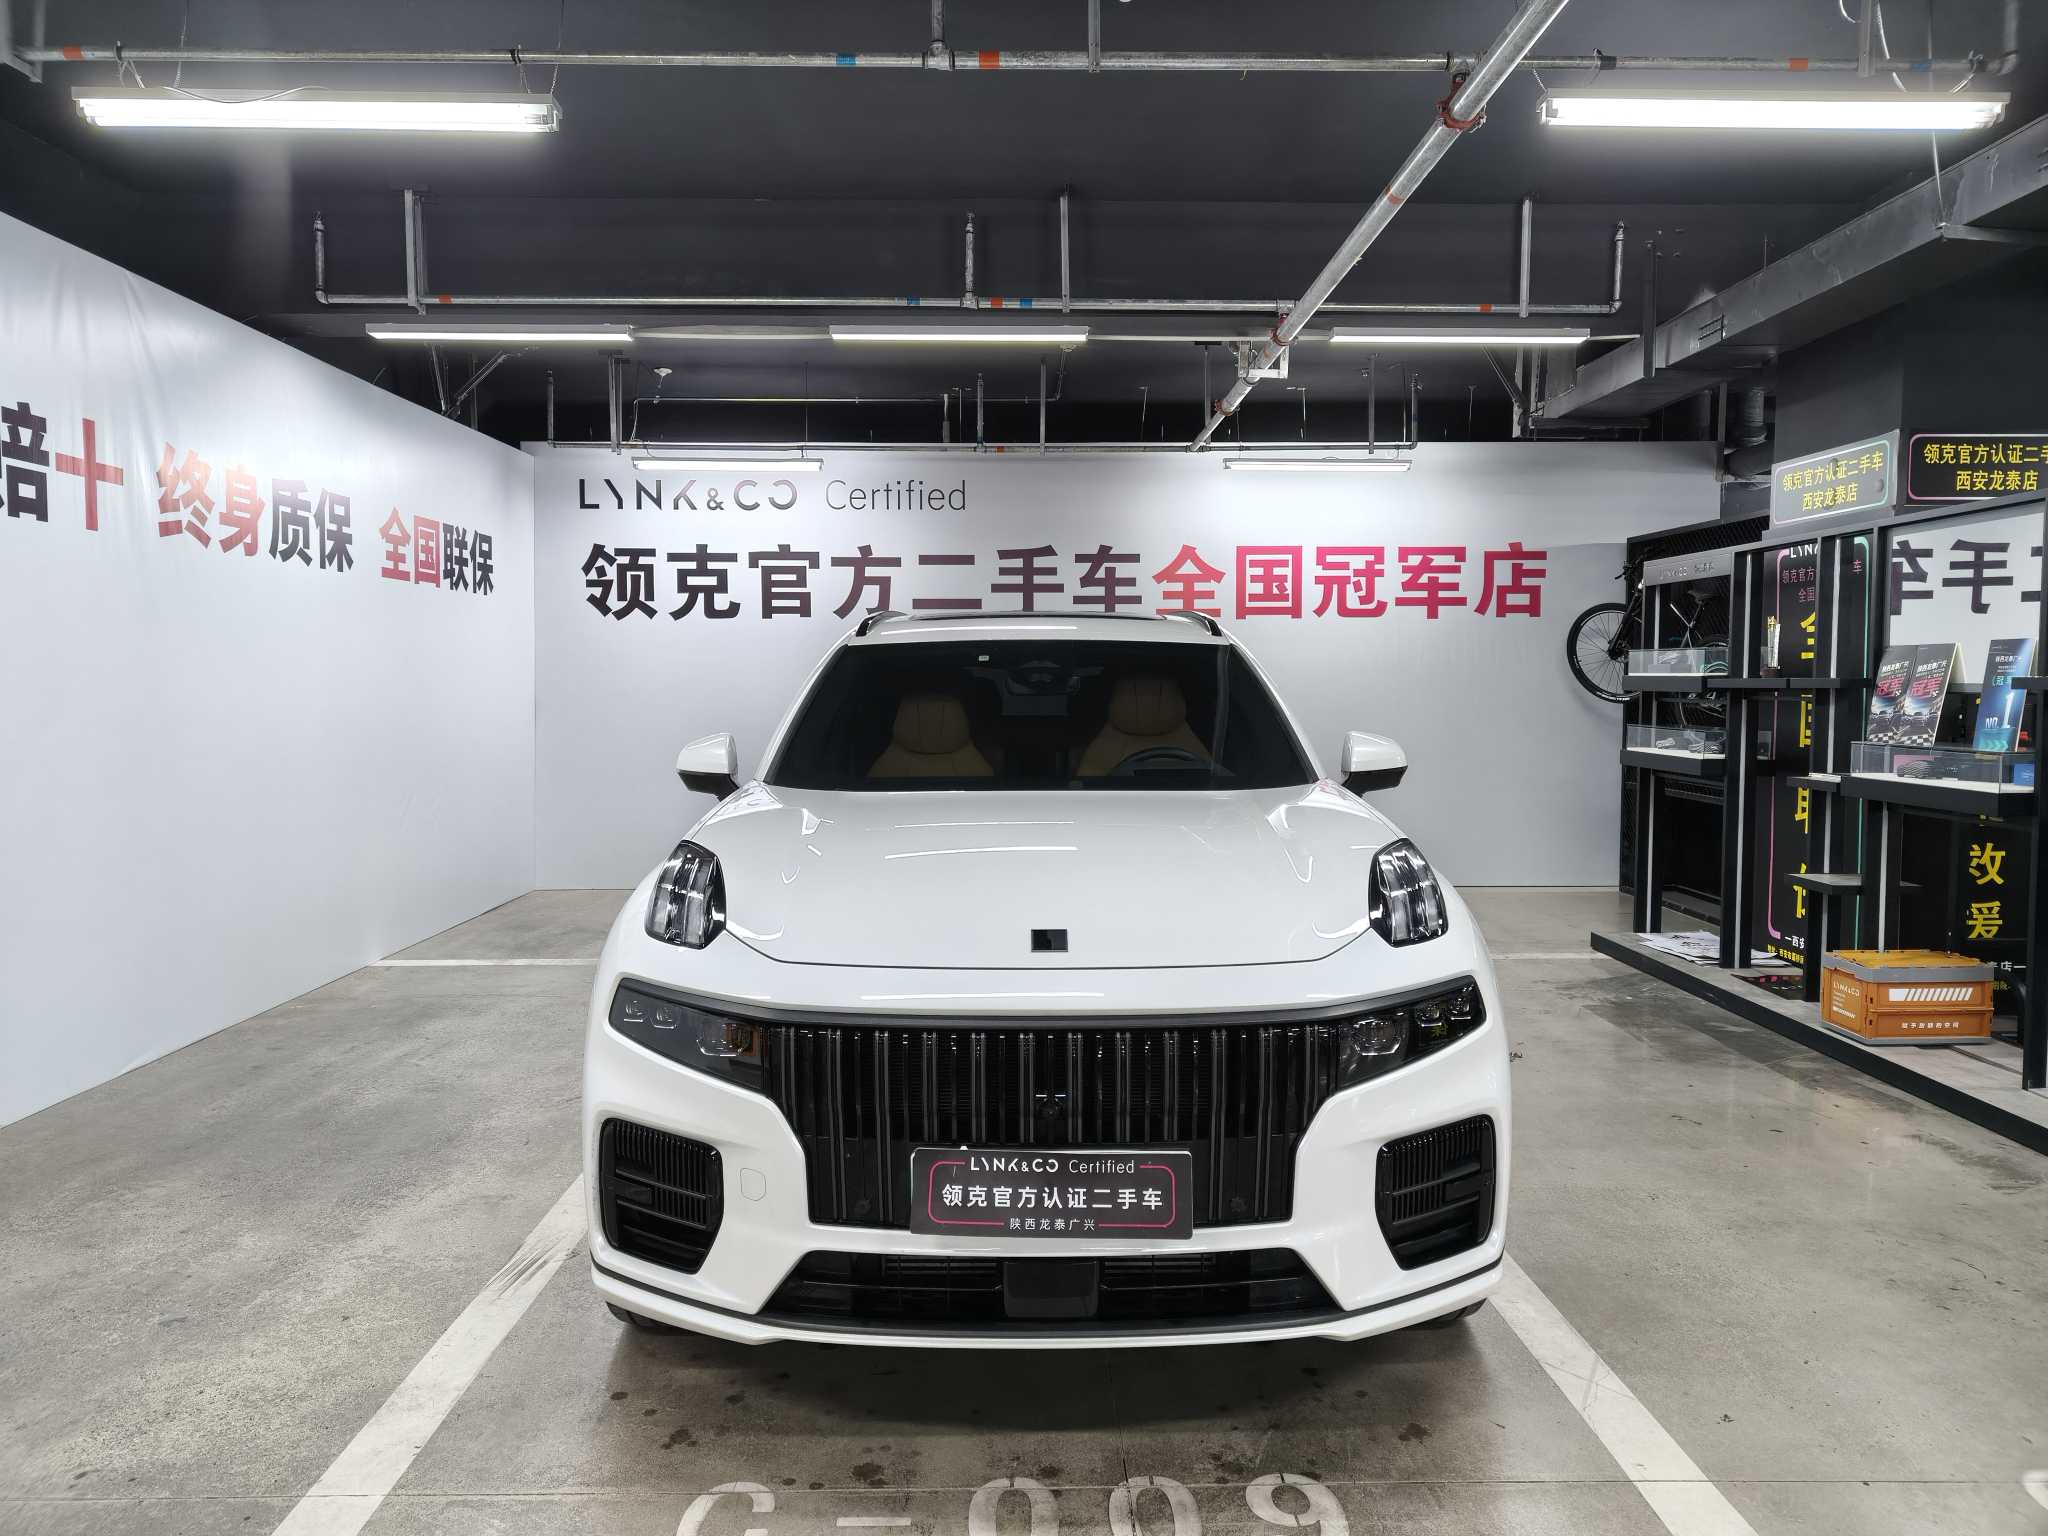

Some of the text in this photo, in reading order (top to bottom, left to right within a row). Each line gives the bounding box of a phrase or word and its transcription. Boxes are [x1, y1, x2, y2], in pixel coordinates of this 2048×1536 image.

[1783, 450, 1884, 491] 领克官方认证二手车
[1956, 470, 2039, 491] 西安龙泰店
[578, 478, 967, 511] LYNK&CO Certified
[1802, 483, 1859, 512] 西安龙泰店
[156, 441, 354, 573] 终身质保
[378, 506, 495, 596] 全国联保
[581, 541, 1548, 621] 领克官方二手车全国冠军店
[970, 1156, 1135, 1174] LYNK&CO Certified
[942, 1184, 1163, 1210] 领克官方认证二手车
[1009, 1217, 1096, 1231] 陕西龙泰广兴
